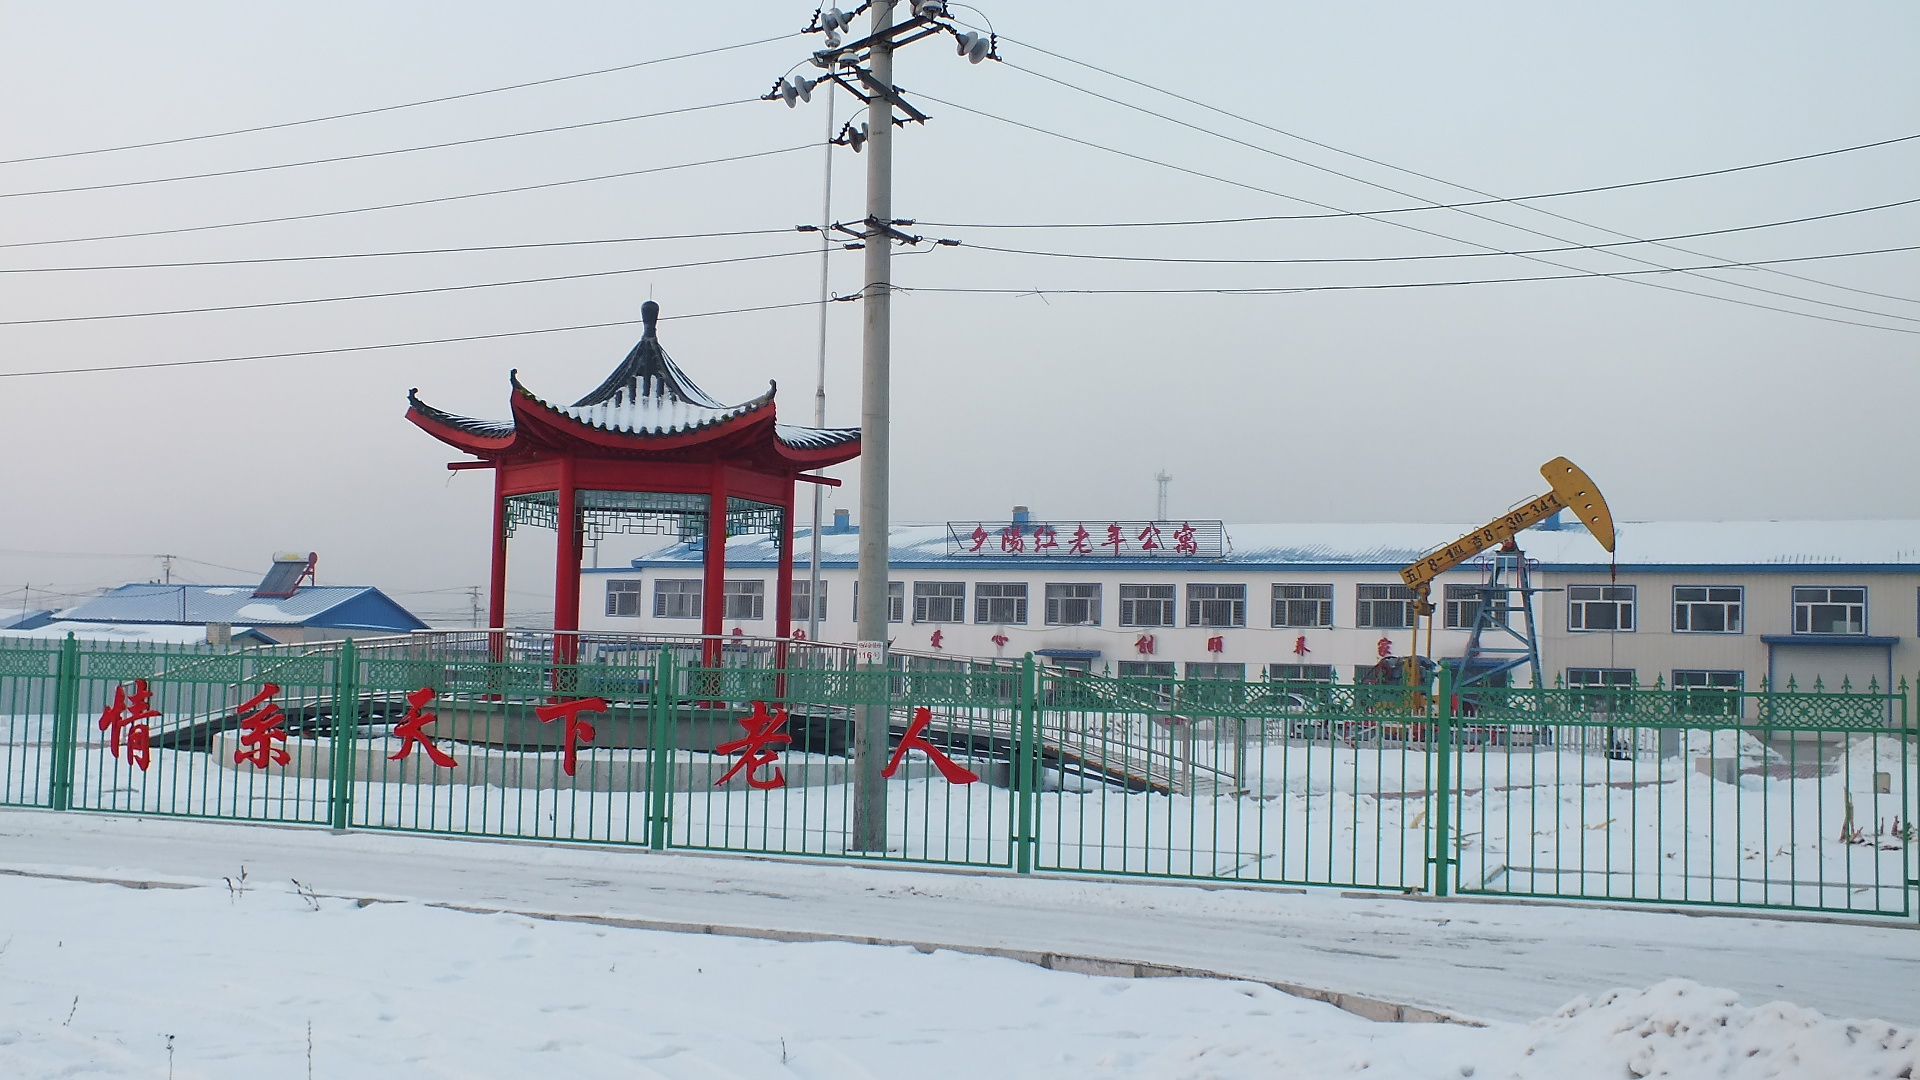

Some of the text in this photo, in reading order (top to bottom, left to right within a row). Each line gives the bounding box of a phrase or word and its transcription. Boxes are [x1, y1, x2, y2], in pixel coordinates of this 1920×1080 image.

[98, 678, 979, 790] 情系天下老人
